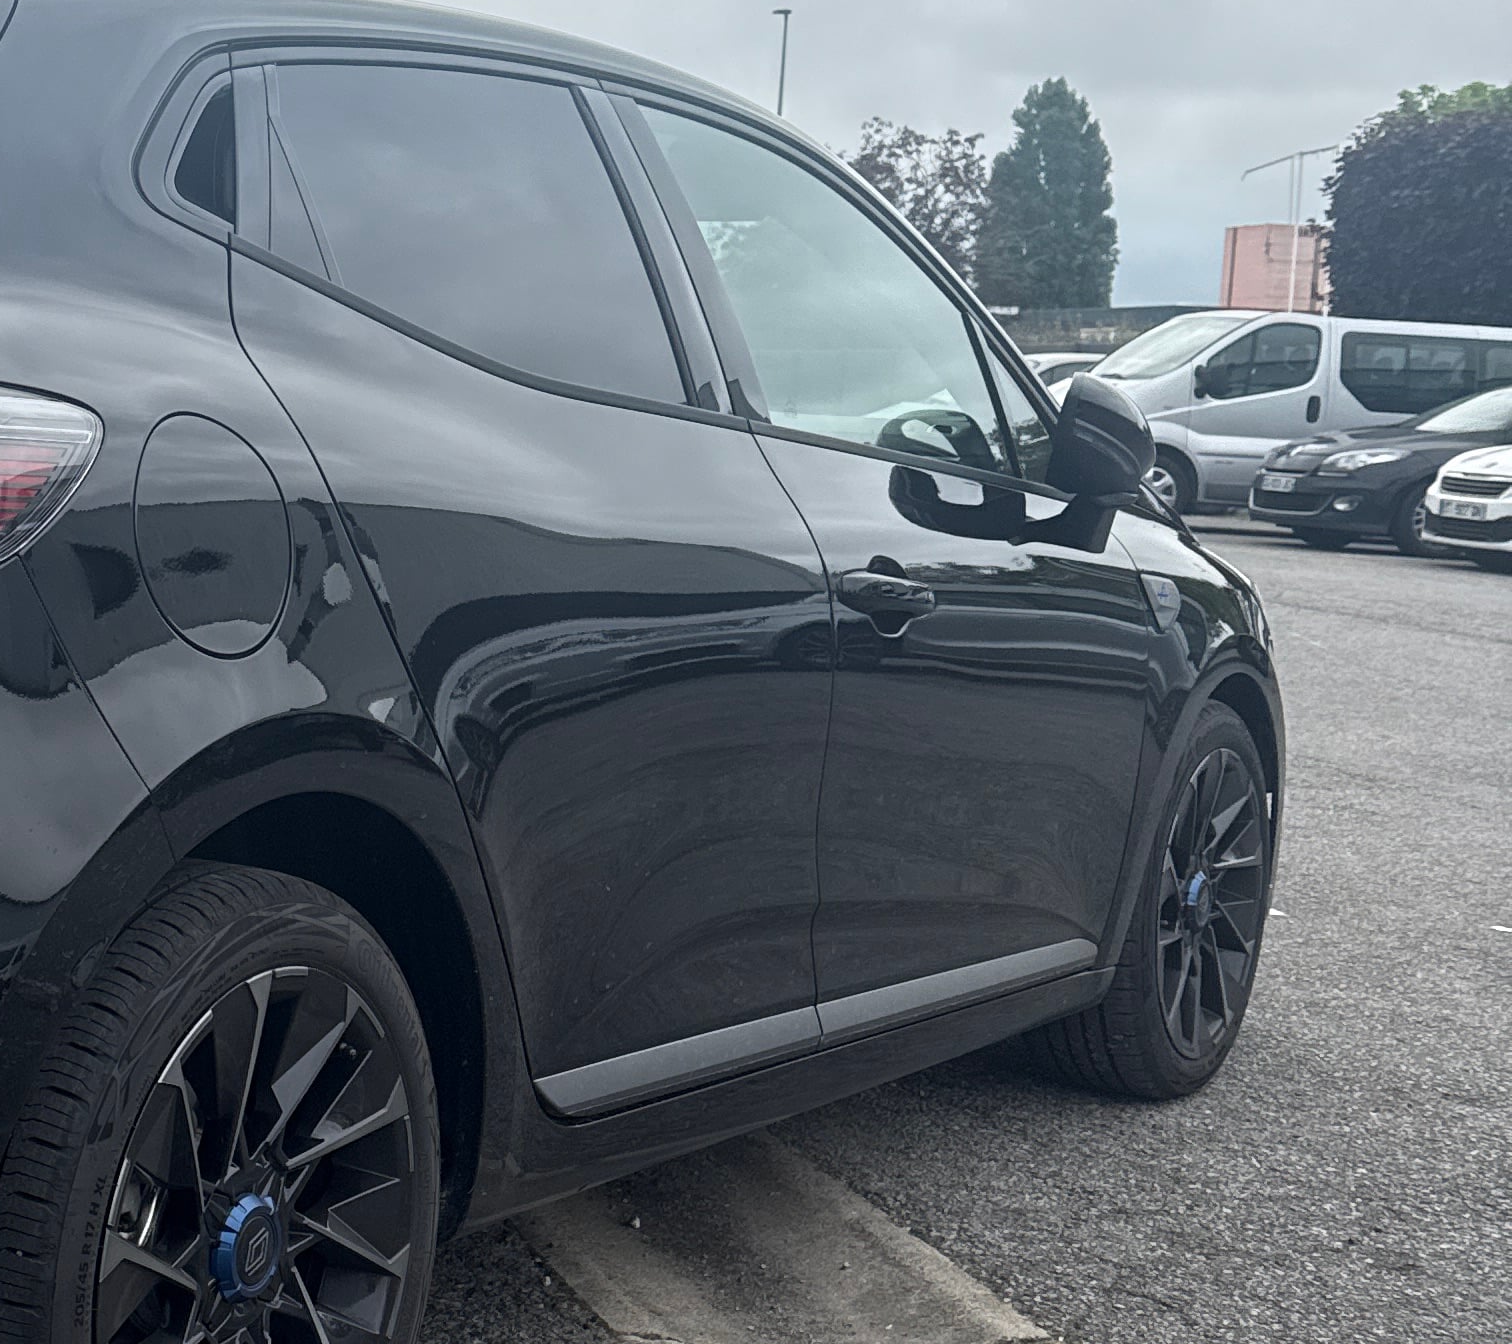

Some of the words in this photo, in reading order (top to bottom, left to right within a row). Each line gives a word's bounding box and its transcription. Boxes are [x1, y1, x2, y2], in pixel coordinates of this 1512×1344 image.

[72, 1262, 89, 1328] 205/45
[84, 1221, 96, 1238] 17
[93, 1174, 108, 1196] XL
